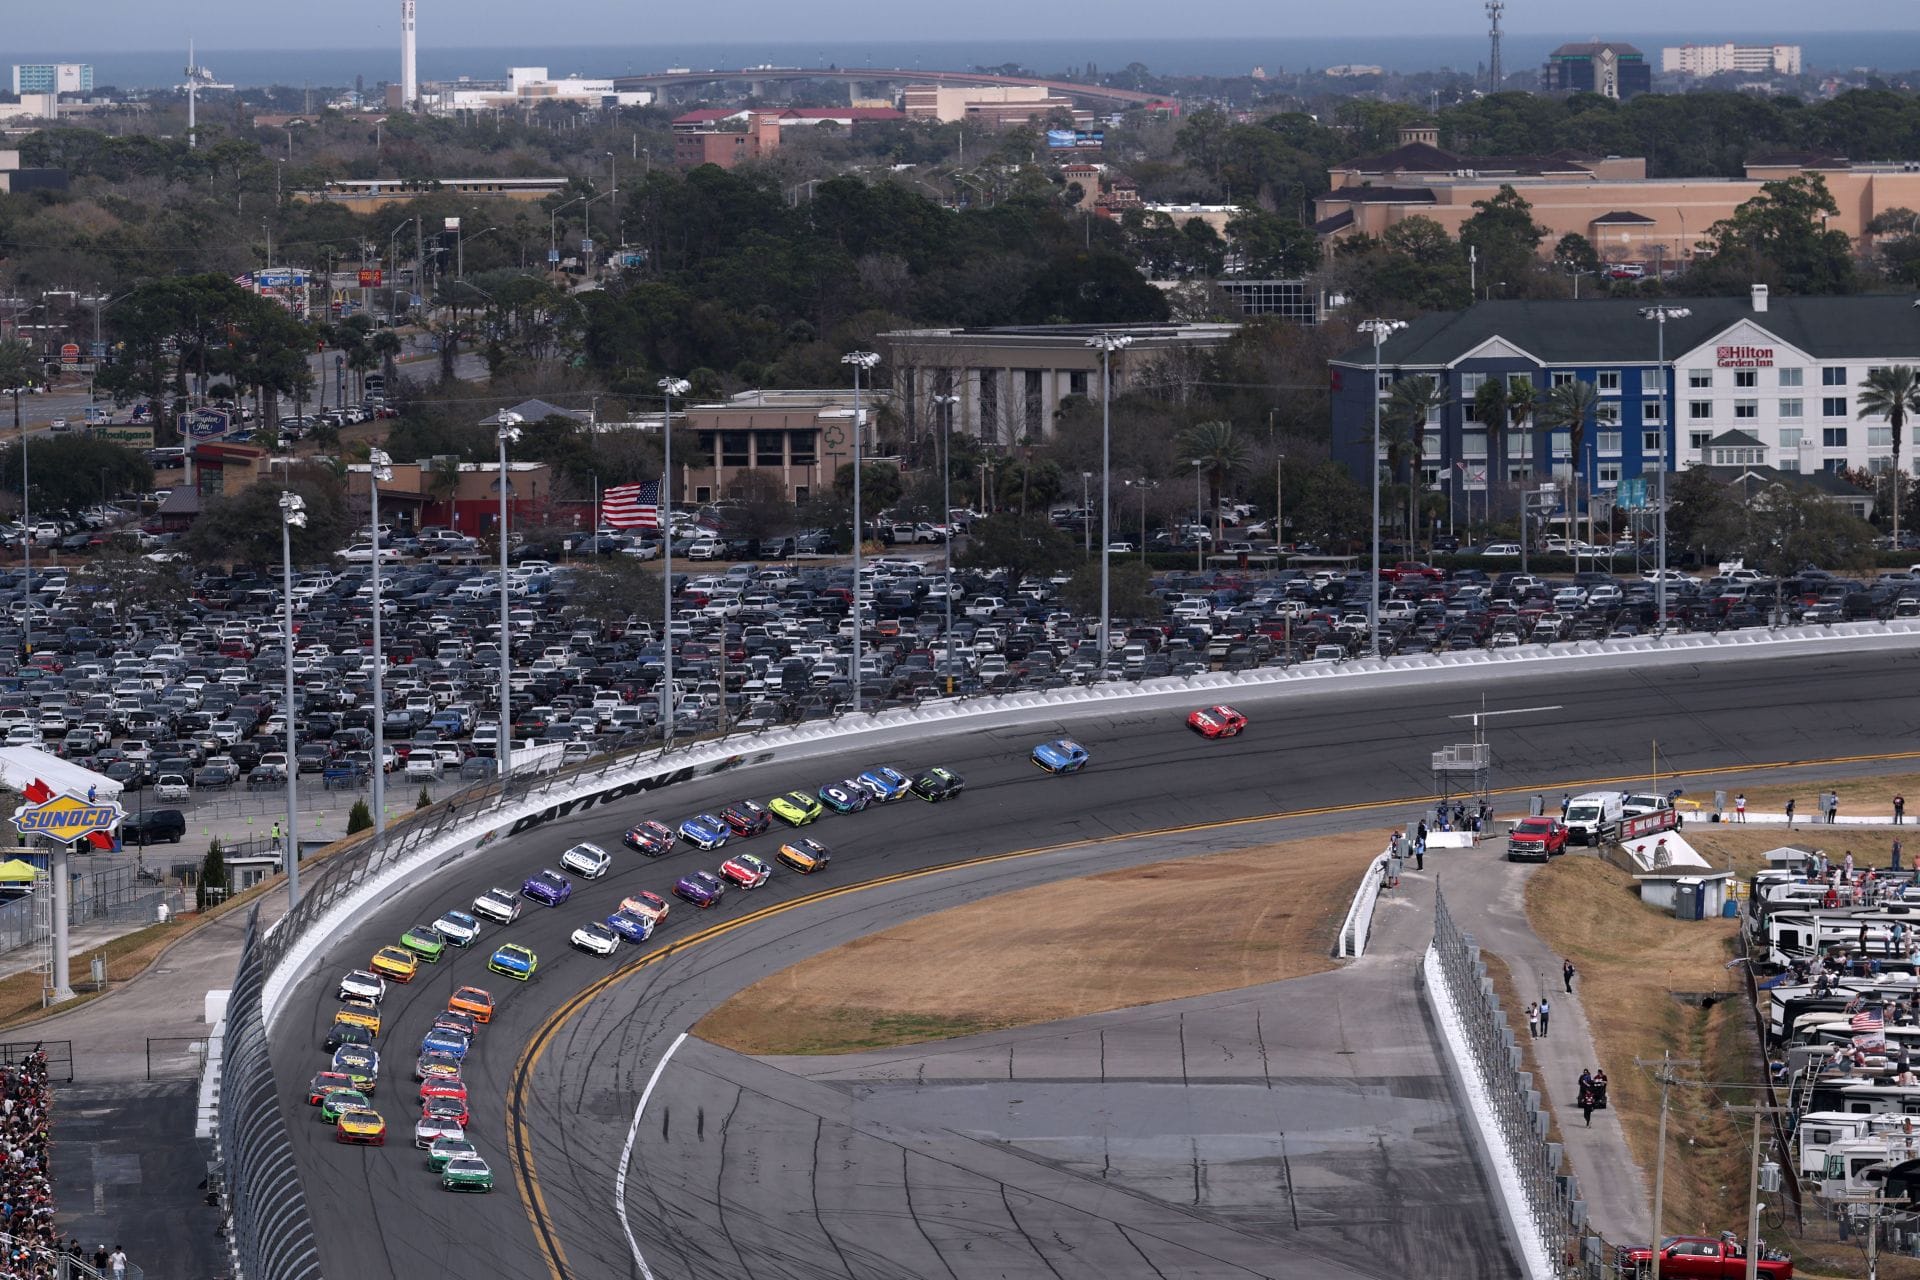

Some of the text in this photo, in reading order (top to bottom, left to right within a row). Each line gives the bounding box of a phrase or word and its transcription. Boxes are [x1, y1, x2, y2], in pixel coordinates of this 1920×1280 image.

[1730, 346, 1773, 359] Hilton
[1717, 358, 1774, 368] Garden Inn
[508, 765, 695, 837] DAYTONA
[24, 808, 112, 829] SUNOCO
